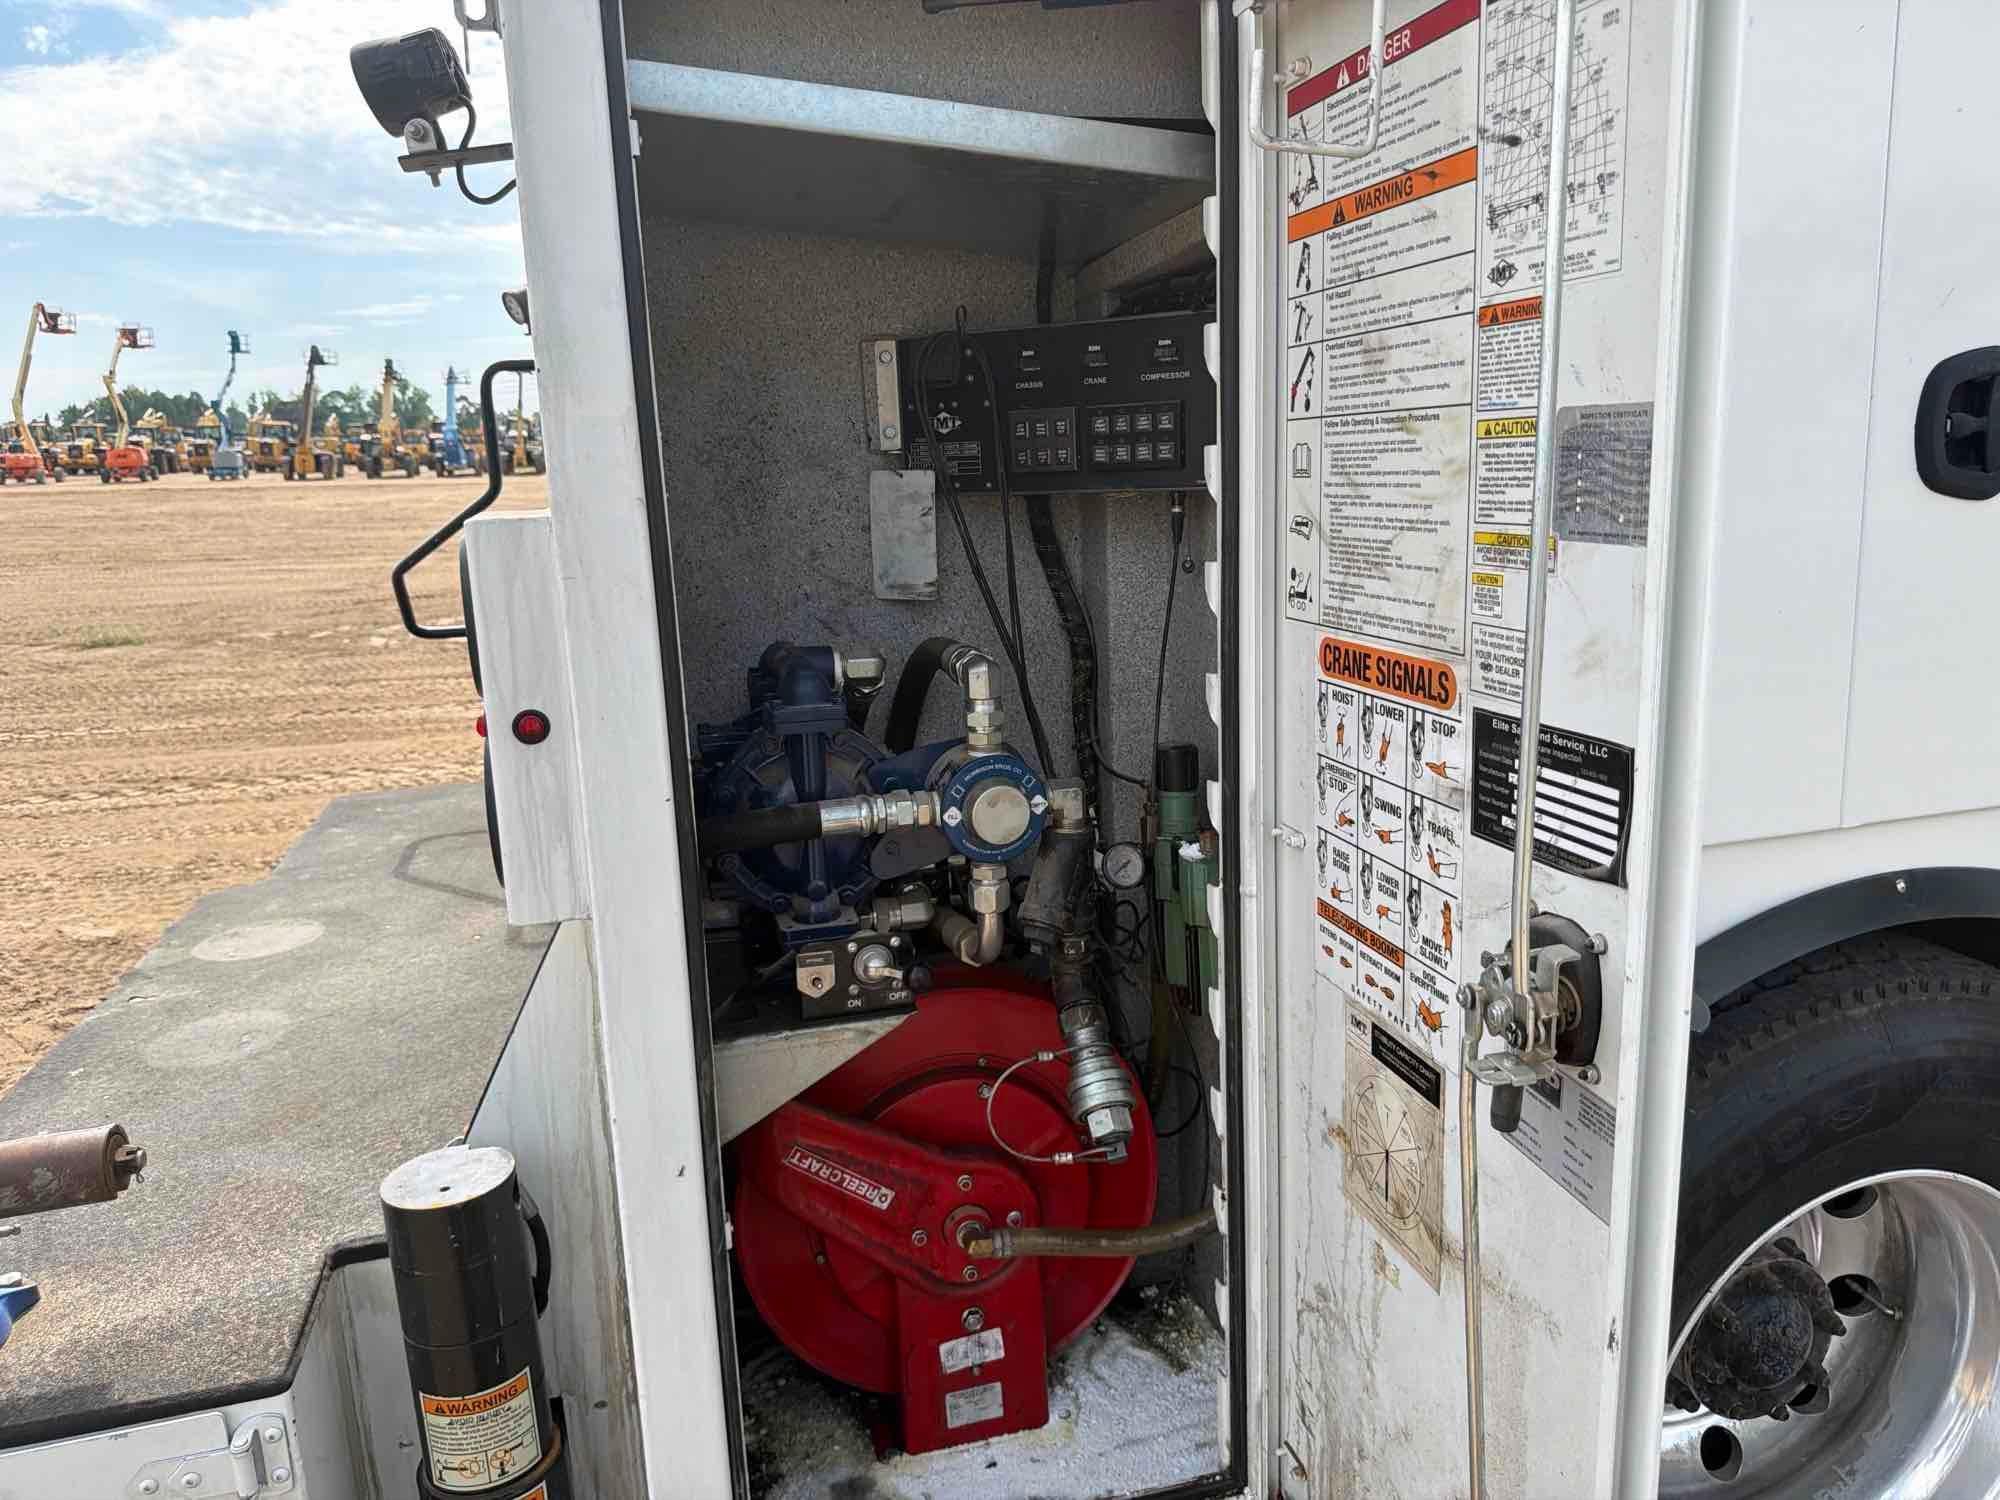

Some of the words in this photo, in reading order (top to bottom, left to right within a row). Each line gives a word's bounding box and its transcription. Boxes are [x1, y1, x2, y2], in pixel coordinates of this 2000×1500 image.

[1357, 29, 1411, 76] DAGER
[1354, 175, 1413, 214] WARNING
[1083, 377, 1108, 385] CRANE
[1140, 370, 1191, 381] COMPRESSOR
[1016, 381, 1043, 389] CHASSIS
[1408, 413, 1440, 424] Procedures
[1493, 418, 1536, 435] CAUTION
[1496, 536, 1529, 547] CAUTION
[1477, 576, 1498, 584] CAUTION
[1475, 650, 1491, 662] YOUR
[1493, 653, 1525, 667] AUTHORIZ
[1323, 643, 1371, 683] CRANE
[1376, 656, 1449, 704] SIGNALS
[1495, 665, 1520, 679] DEALER
[1332, 690, 1354, 707] HOIST
[1375, 703, 1404, 722] LOWER
[1431, 719, 1456, 737] STOP
[1492, 719, 1510, 732] Elite
[1552, 735, 1587, 754] Service,
[1589, 744, 1609, 758] LLC
[1325, 762, 1356, 781] EMERGENCY
[1329, 777, 1348, 793] STOP
[1374, 797, 1402, 818] SWING
[1427, 820, 1456, 847] TRAVEL
[1332, 847, 1350, 863] RAISE
[1332, 859, 1350, 874] BOOM
[1376, 870, 1399, 890] LOWER
[1377, 882, 1398, 900] BOOM
[1319, 902, 1369, 942] TELESCOPING
[1370, 932, 1400, 963] BOOMS
[1320, 924, 1338, 941] EXTEND
[1339, 937, 1354, 952] BOOM
[1422, 935, 1444, 955] MOVE
[1360, 951, 1383, 972] RETRACT
[1384, 967, 1400, 983] BOOM
[1420, 946, 1448, 971] SLOWLY
[1422, 970, 1436, 986] DOG
[889, 992, 907, 1000] OFF
[1410, 972, 1448, 1004] EVERYTHING
[848, 1000, 862, 1008] ON
[788, 1149, 879, 1203] REELCRAFT
[447, 1385, 518, 1413] WARNING
